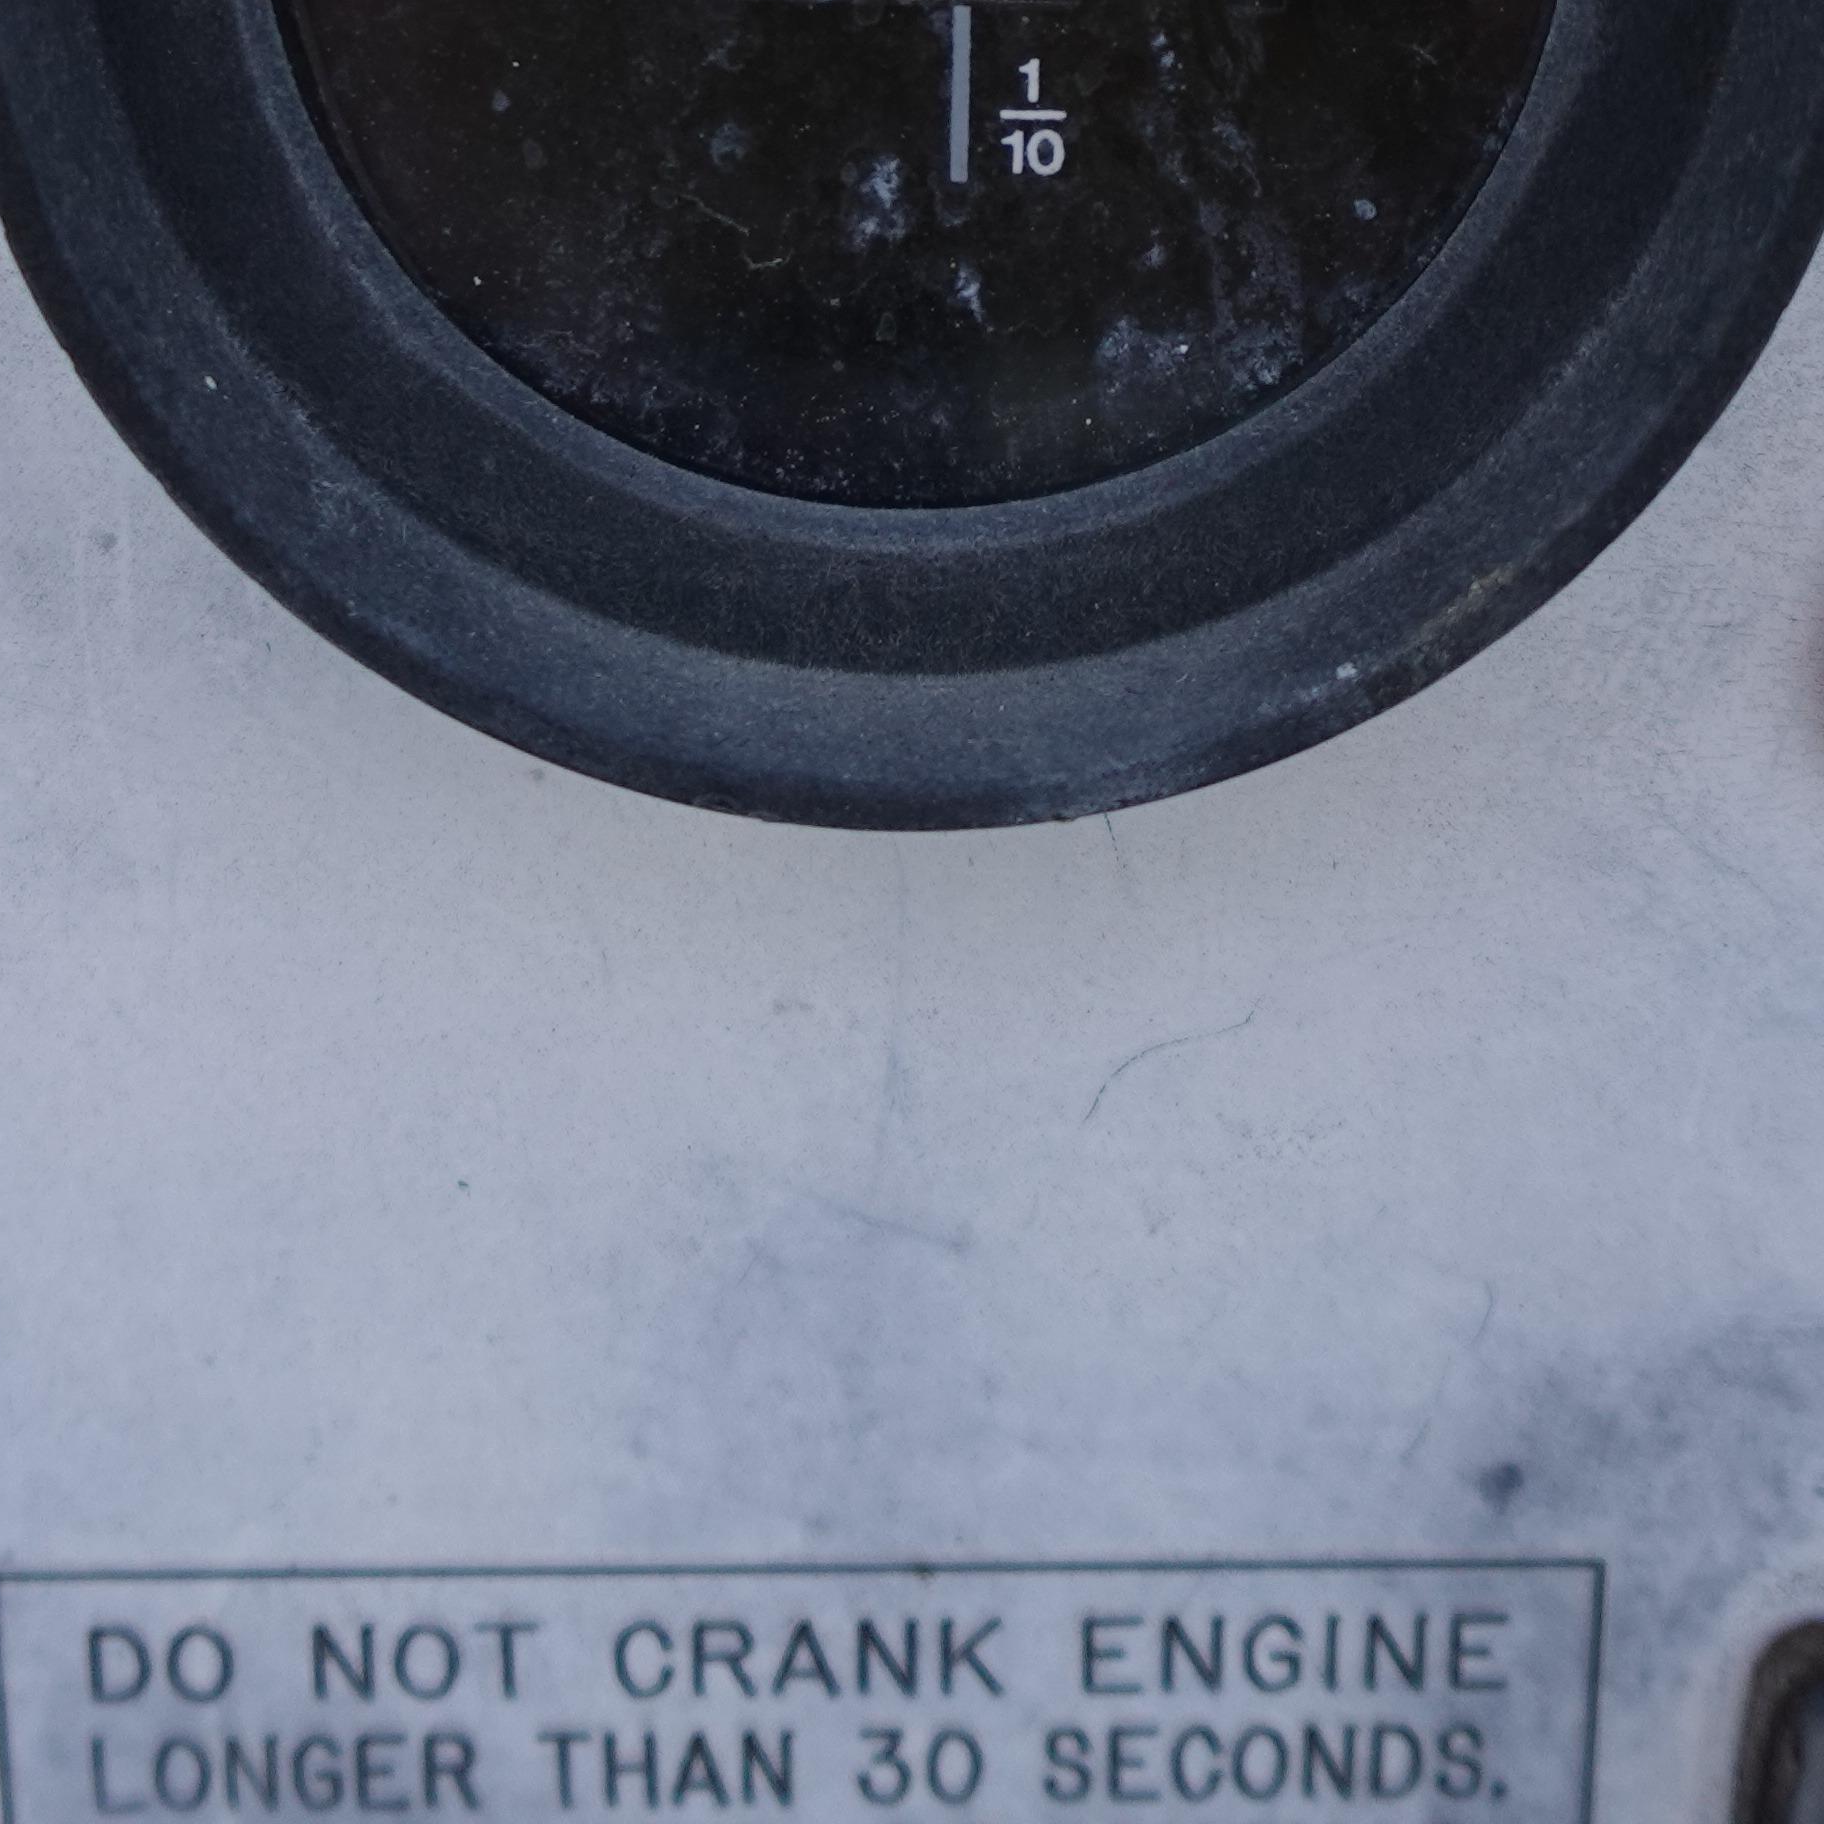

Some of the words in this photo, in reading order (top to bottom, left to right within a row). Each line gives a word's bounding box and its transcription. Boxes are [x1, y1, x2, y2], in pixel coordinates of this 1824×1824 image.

[87, 1622, 234, 1704] DO
[310, 1620, 538, 1703] NOT
[613, 1616, 1005, 1699] CRANK
[1080, 1613, 1511, 1696] ENGINE
[89, 1731, 482, 1815] LONGER
[537, 1728, 795, 1810] THAN
[856, 1726, 985, 1807] 30
[1042, 1721, 1509, 1807] SECONDS.
